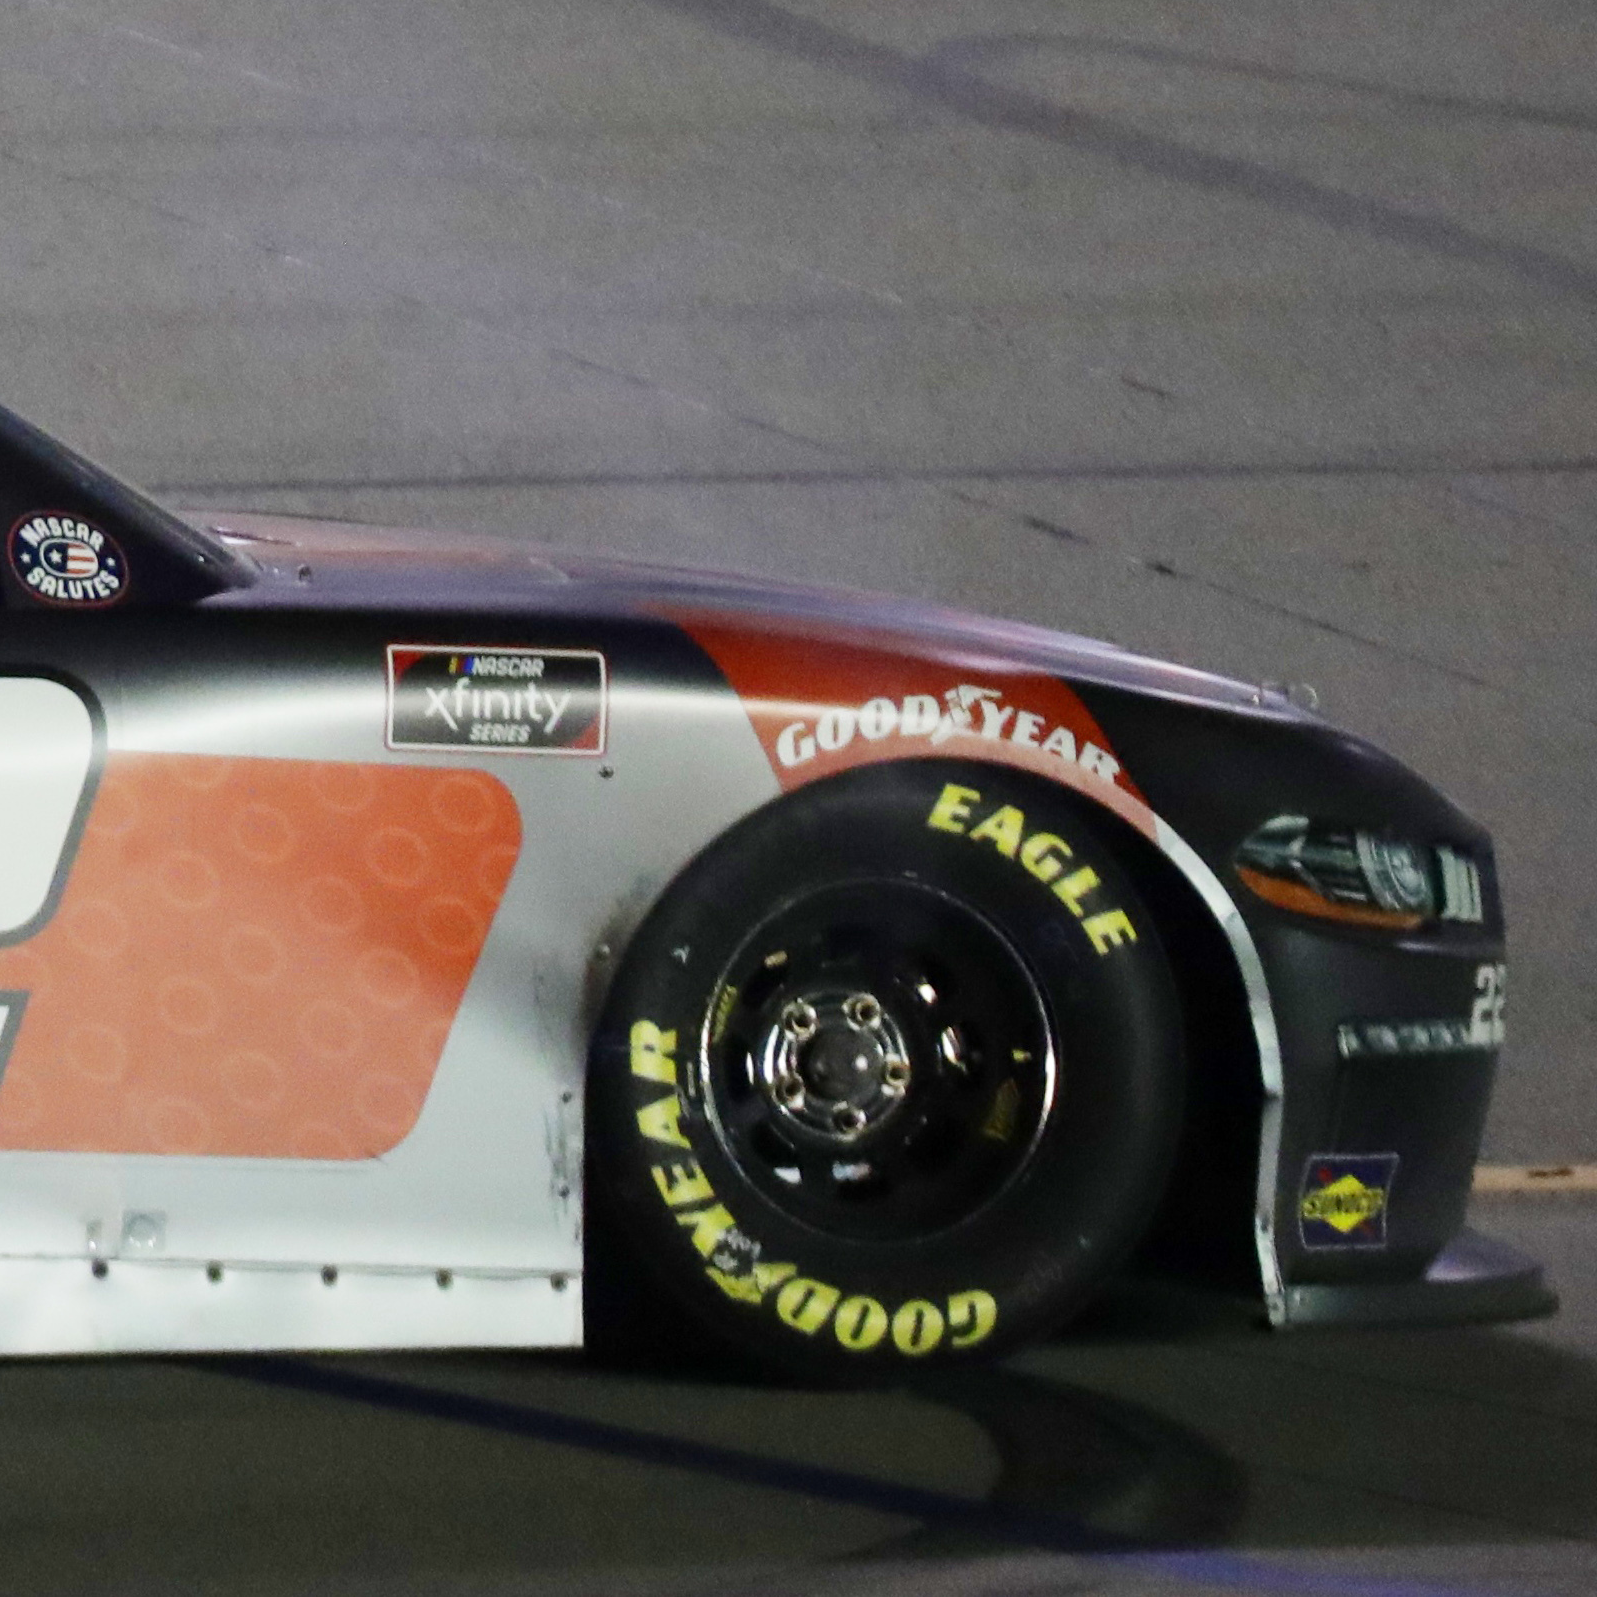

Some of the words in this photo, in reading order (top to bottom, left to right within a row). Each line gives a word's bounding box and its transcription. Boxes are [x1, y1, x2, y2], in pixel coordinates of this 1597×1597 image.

[18, 516, 104, 552] NASCAR
[26, 566, 120, 599] SALUTES
[472, 656, 546, 678] NASCAR
[424, 677, 572, 735] xfinity
[469, 722, 532, 743] SERIES
[776, 684, 1121, 784] GOODYEAR
[927, 782, 1138, 956] EAGLE
[630, 1020, 997, 1356] GOODYEAR
